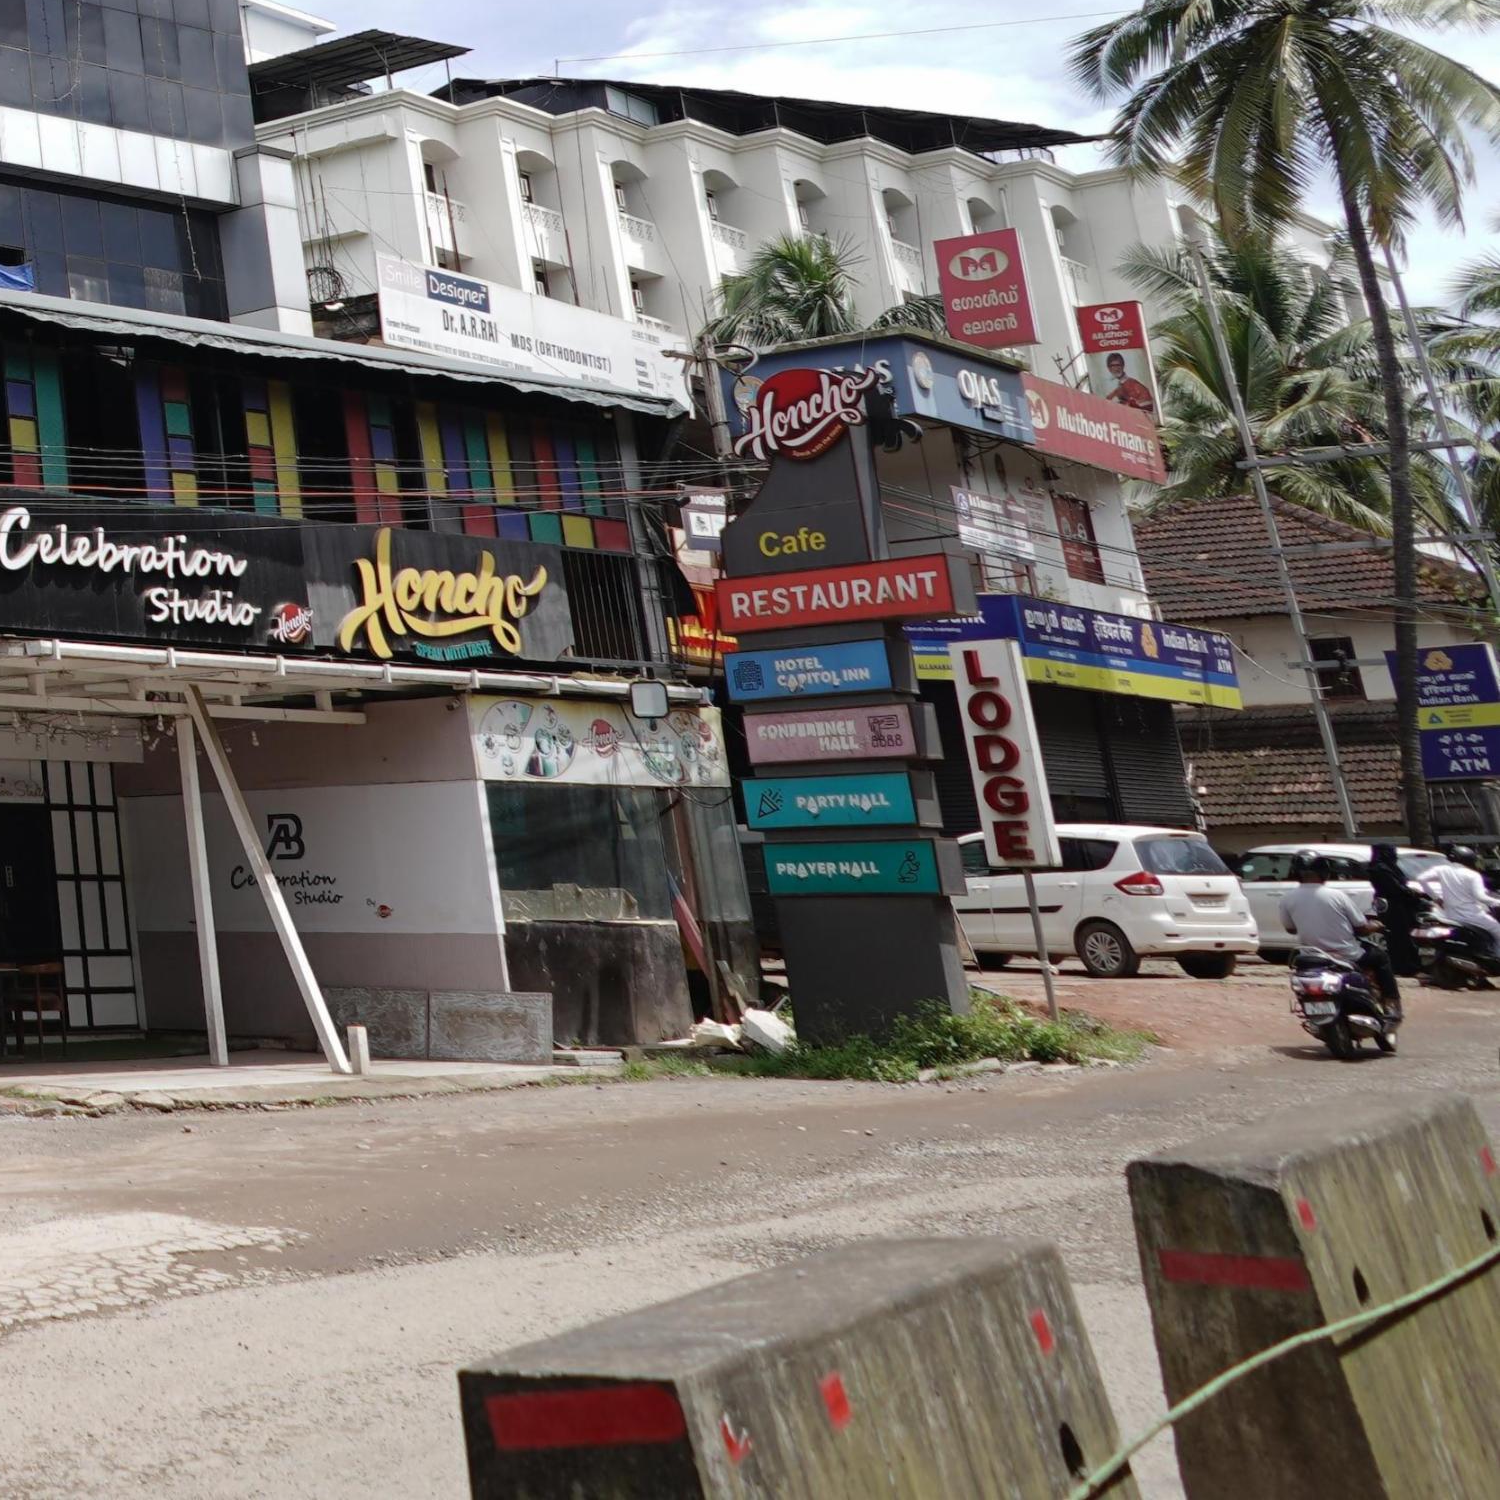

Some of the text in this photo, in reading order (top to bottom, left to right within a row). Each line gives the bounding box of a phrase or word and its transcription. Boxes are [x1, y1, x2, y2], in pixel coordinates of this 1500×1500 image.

[385, 264, 487, 305] Smile Designer
[511, 333, 533, 352] MDS
[535, 339, 612, 373] (ORTHODONTIST)
[1099, 338, 1129, 347] Group
[957, 369, 1001, 408] OJAS
[735, 369, 876, 461] Honcho
[1056, 405, 1110, 442] Muthoot
[0, 507, 248, 578] Celebration
[759, 528, 826, 557] Cafe
[149, 588, 261, 626] Studio
[340, 527, 548, 659] Honcho
[731, 571, 938, 618] RESTAURANT
[274, 607, 313, 643] Honcho
[1161, 628, 1188, 650] Indian
[1186, 633, 1209, 654] Bank
[774, 656, 824, 672] HOTEL
[777, 667, 872, 690] CAPITOL INN
[1418, 693, 1480, 706] Indian Bank
[757, 719, 857, 739] CONFERENCE
[819, 736, 862, 751] HALL
[963, 650, 1036, 861] LODGE
[1449, 758, 1491, 773] ATM
[795, 792, 890, 815] PARTY HALL
[776, 861, 881, 879] PRAYER HALL
[294, 881, 344, 904] Studio
